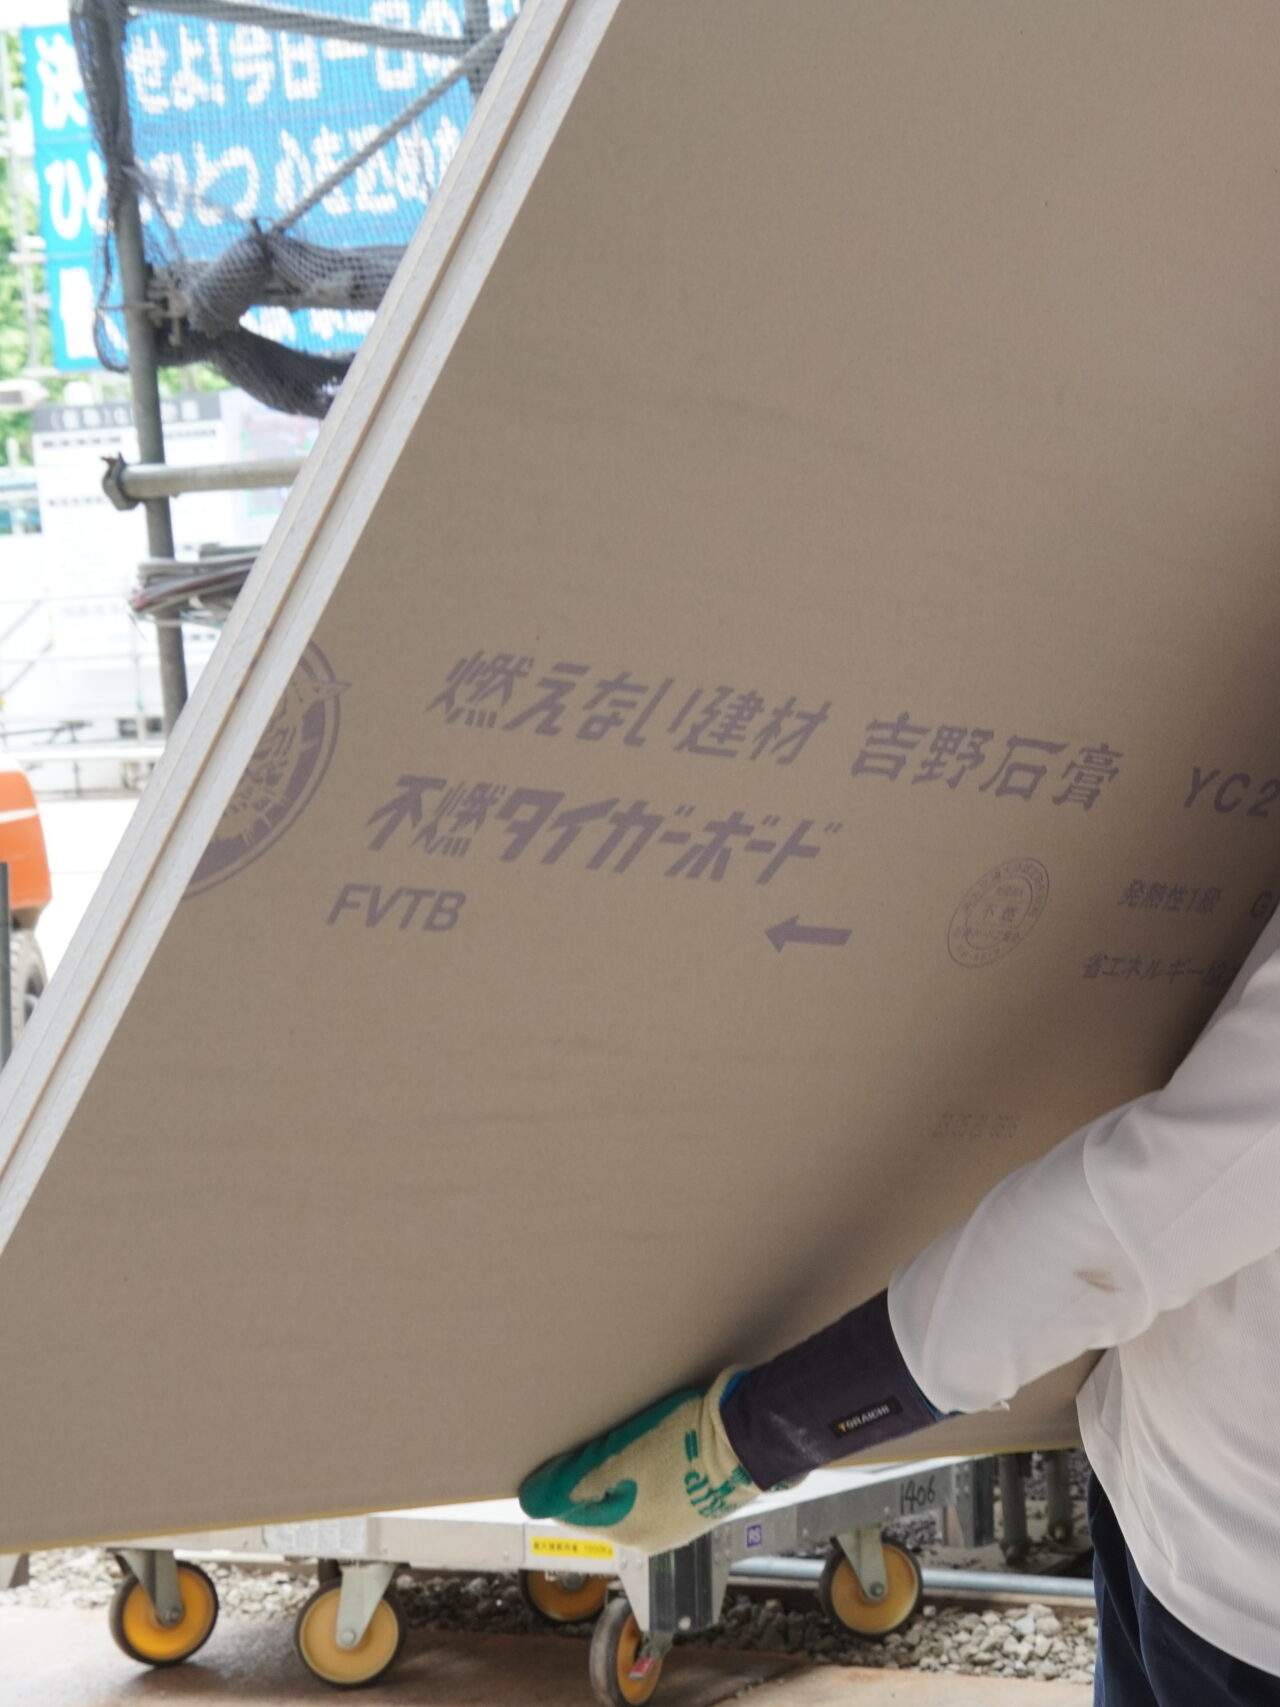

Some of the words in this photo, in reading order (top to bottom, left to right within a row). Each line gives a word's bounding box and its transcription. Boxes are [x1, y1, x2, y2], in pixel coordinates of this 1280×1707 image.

[425, 650, 832, 766] 燃えない建材
[851, 711, 1124, 811] 吉野石膏
[366, 774, 843, 886] 不燃タイガーボード
[326, 883, 467, 932] FVTB
